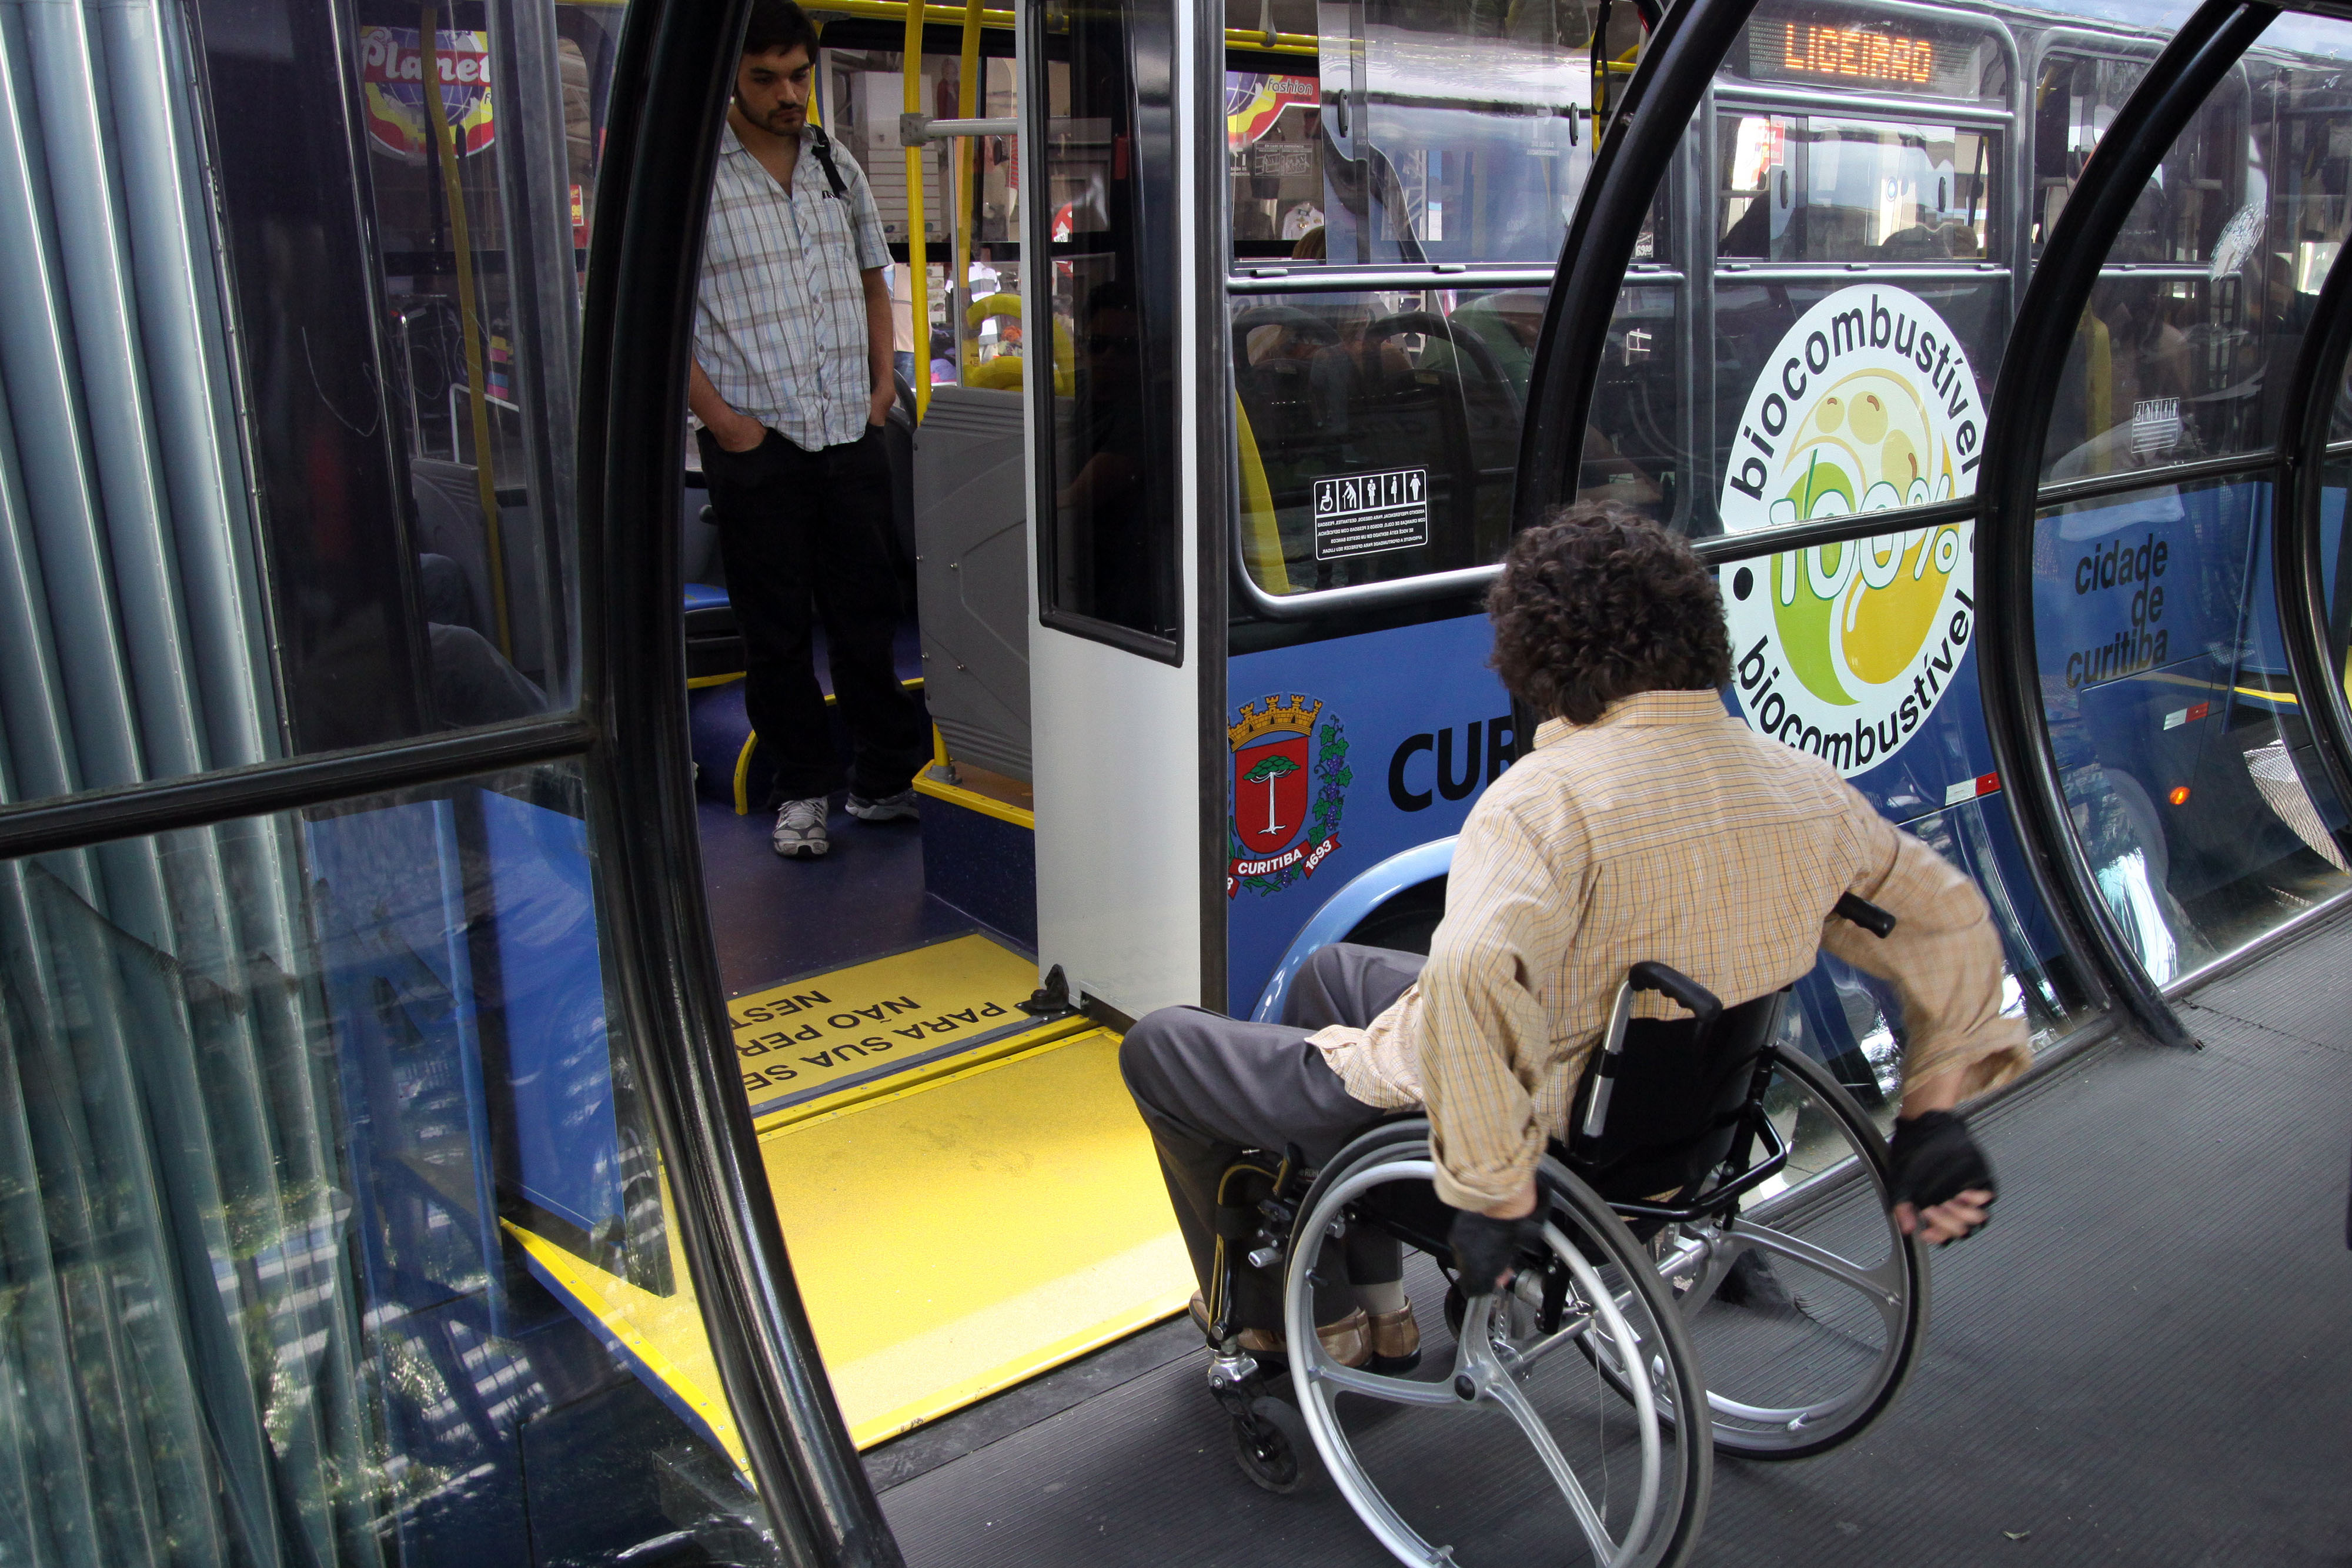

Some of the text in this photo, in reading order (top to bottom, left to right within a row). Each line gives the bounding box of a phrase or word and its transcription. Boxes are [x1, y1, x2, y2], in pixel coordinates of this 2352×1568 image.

[1785, 24, 1932, 83] LIGEIRAO
[1267, 78, 1313, 95] fashion
[1730, 293, 1980, 502] biocombustível
[1769, 473, 1960, 607] 100%
[2075, 533, 2168, 595] cidade
[2132, 586, 2163, 627] de
[1738, 587, 1975, 770] biocombustível
[2066, 623, 2169, 689] curitiba
[1237, 839, 1333, 875] CURITIBA 1693
[827, 995, 921, 1029] NÃO
[892, 1002, 1008, 1041] PARA
[800, 1035, 893, 1068] SUA
